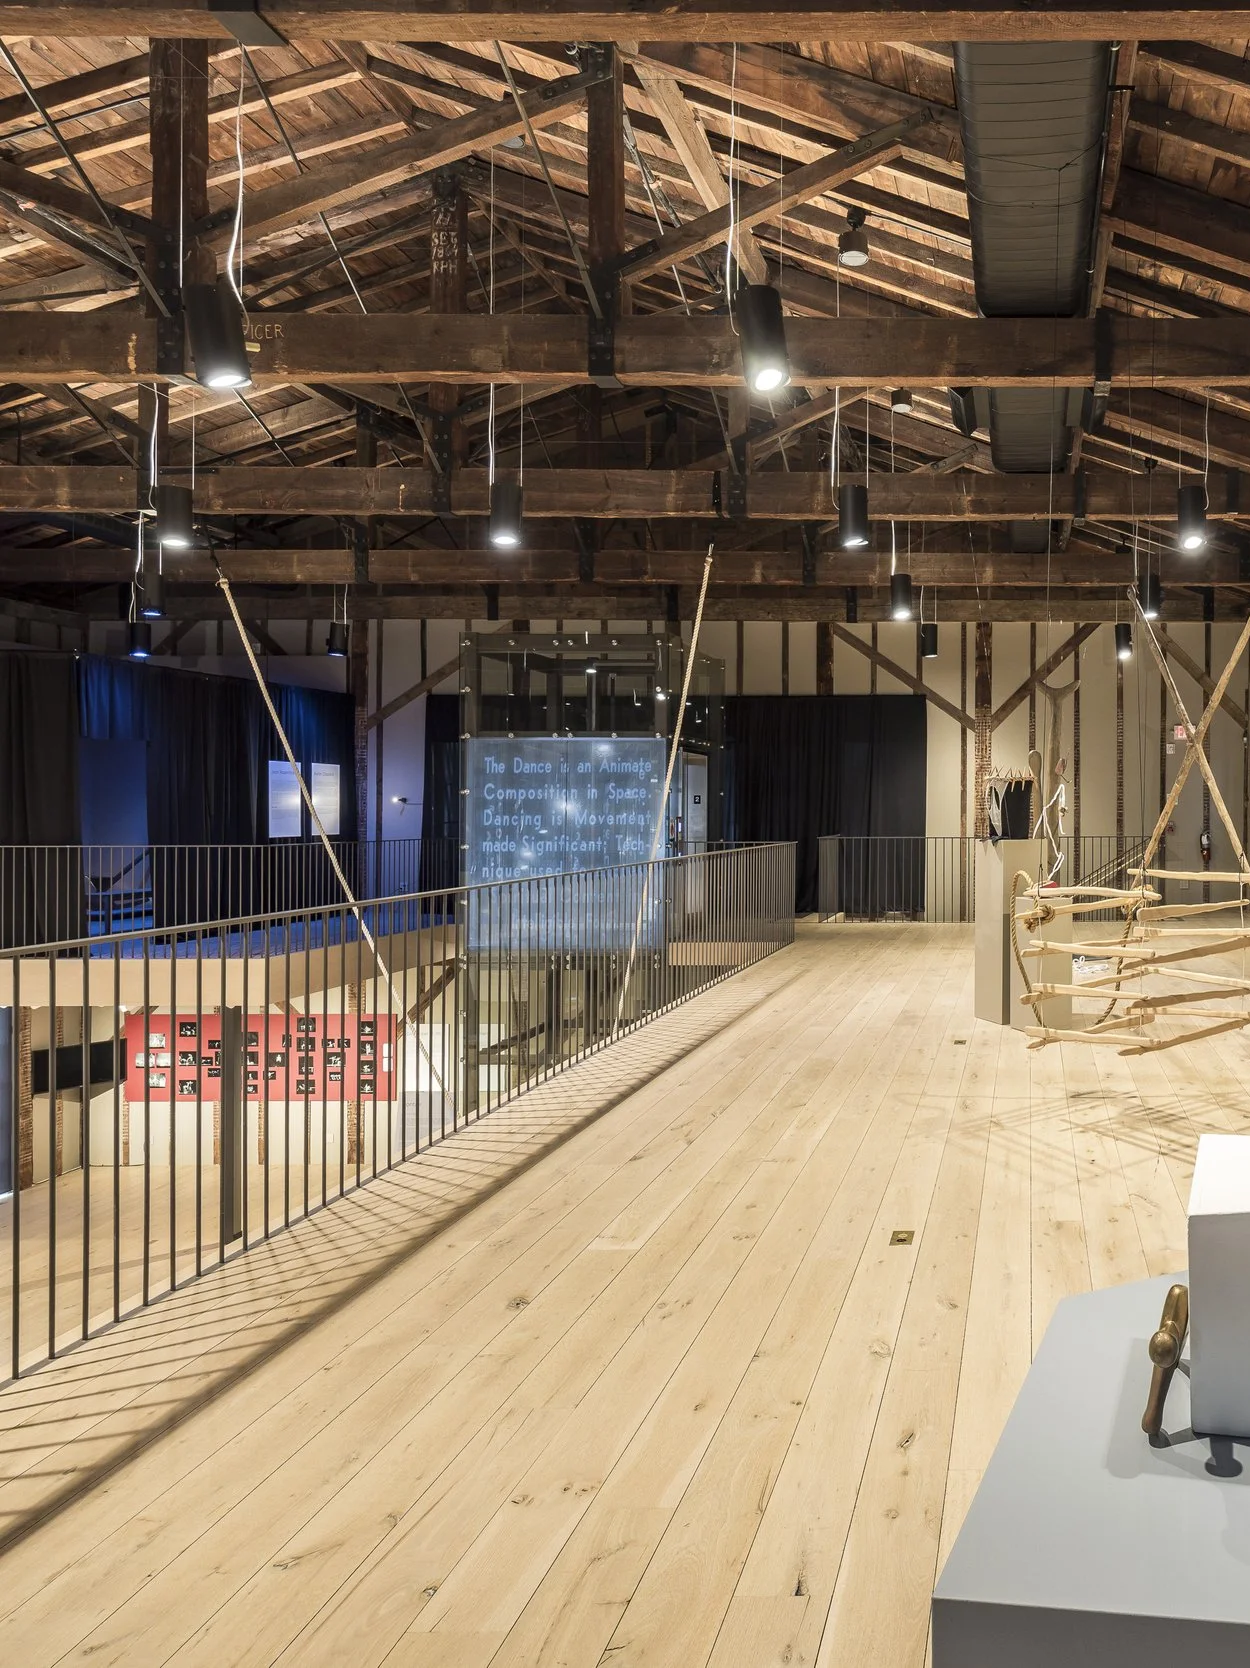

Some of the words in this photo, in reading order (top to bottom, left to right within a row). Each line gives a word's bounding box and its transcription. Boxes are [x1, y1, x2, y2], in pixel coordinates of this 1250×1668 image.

[484, 756, 505, 774] The
[513, 757, 552, 774] Dance
[577, 762, 592, 773] an
[599, 757, 652, 774] Animate
[484, 783, 578, 805] Composition
[587, 784, 598, 800] in
[608, 783, 652, 804] Space.
[483, 809, 542, 830] Dancing
[551, 810, 562, 826] is
[574, 809, 651, 825] Movement
[482, 835, 516, 852] made
[482, 862, 521, 881] nique
[530, 861, 563, 876] used
